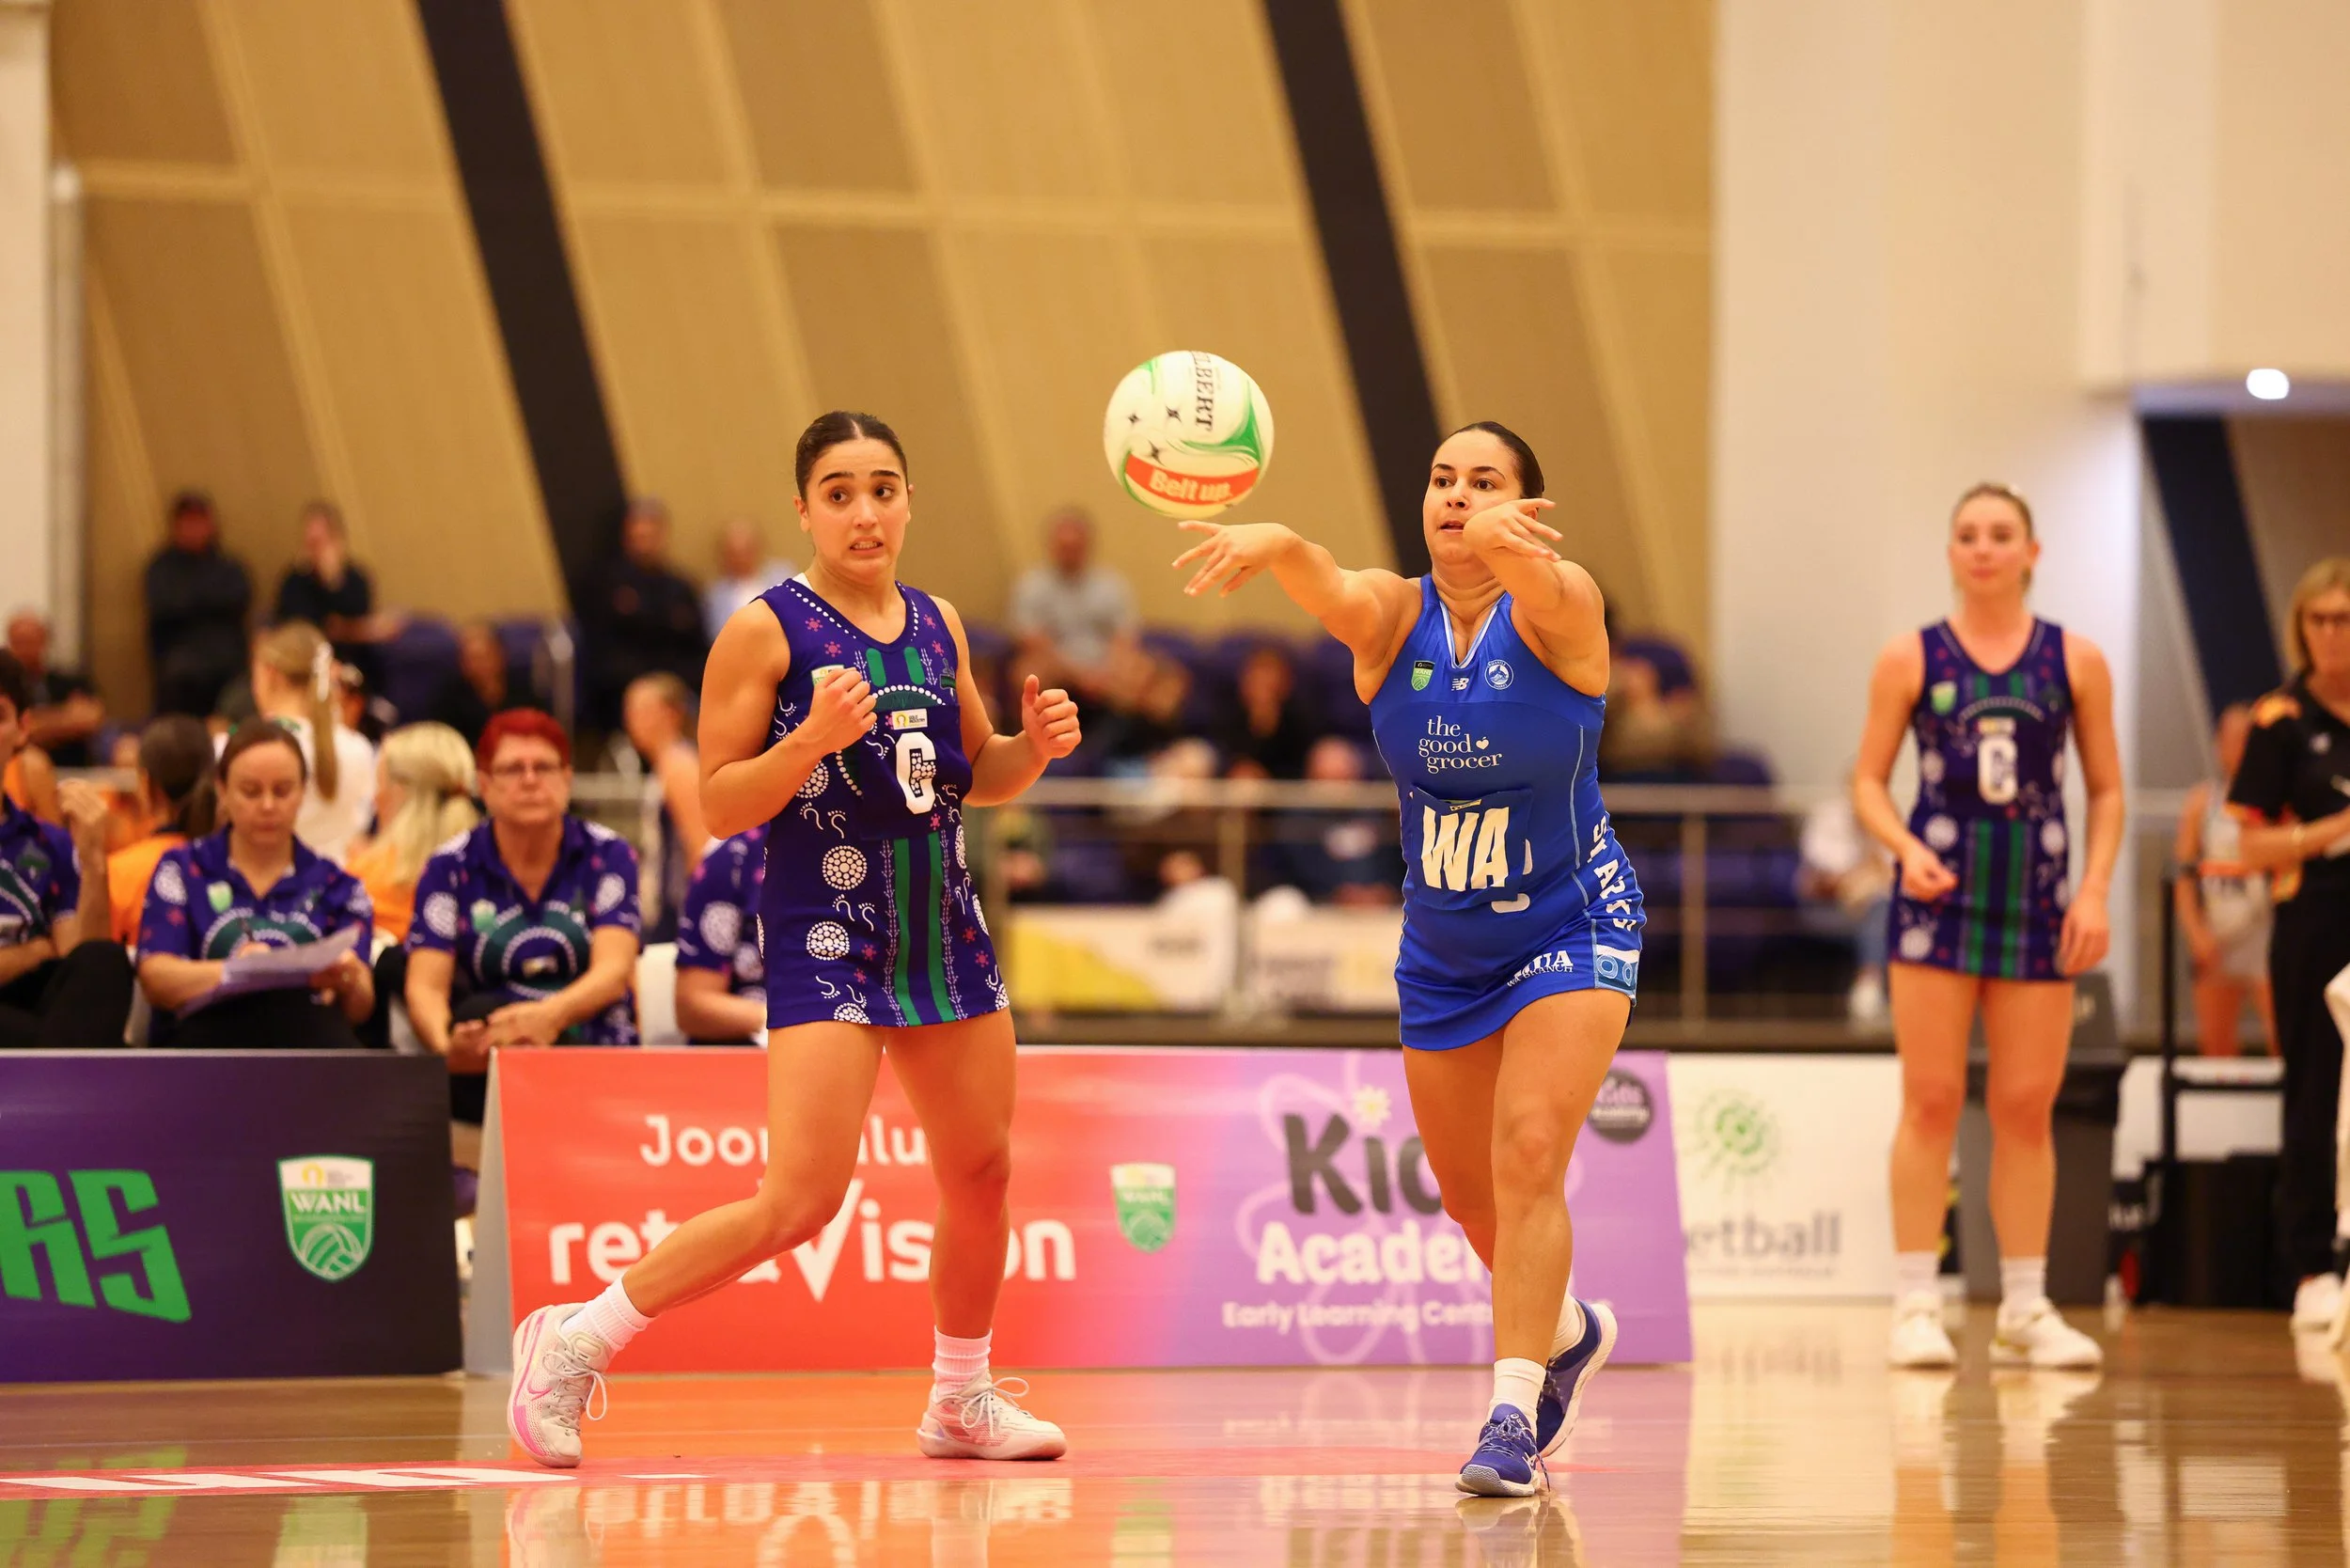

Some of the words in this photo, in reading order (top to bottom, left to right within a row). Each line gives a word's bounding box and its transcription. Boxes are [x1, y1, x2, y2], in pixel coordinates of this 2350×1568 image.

[1149, 467, 1198, 501] Belt
[1427, 714, 1461, 737] the
[1418, 733, 1474, 758] good
[1426, 753, 1503, 775] grocer
[1420, 805, 1510, 892] WA
[1521, 964, 1574, 980] BRANCH
[639, 1114, 927, 1167] Joolu
[1282, 1113, 1444, 1215] Ki
[290, 1191, 367, 1215] WANL
[1682, 1209, 1841, 1258] etball
[1257, 1220, 1493, 1285] Acade
[1223, 1301, 1293, 1335] Early
[1296, 1299, 1420, 1334] Learning
